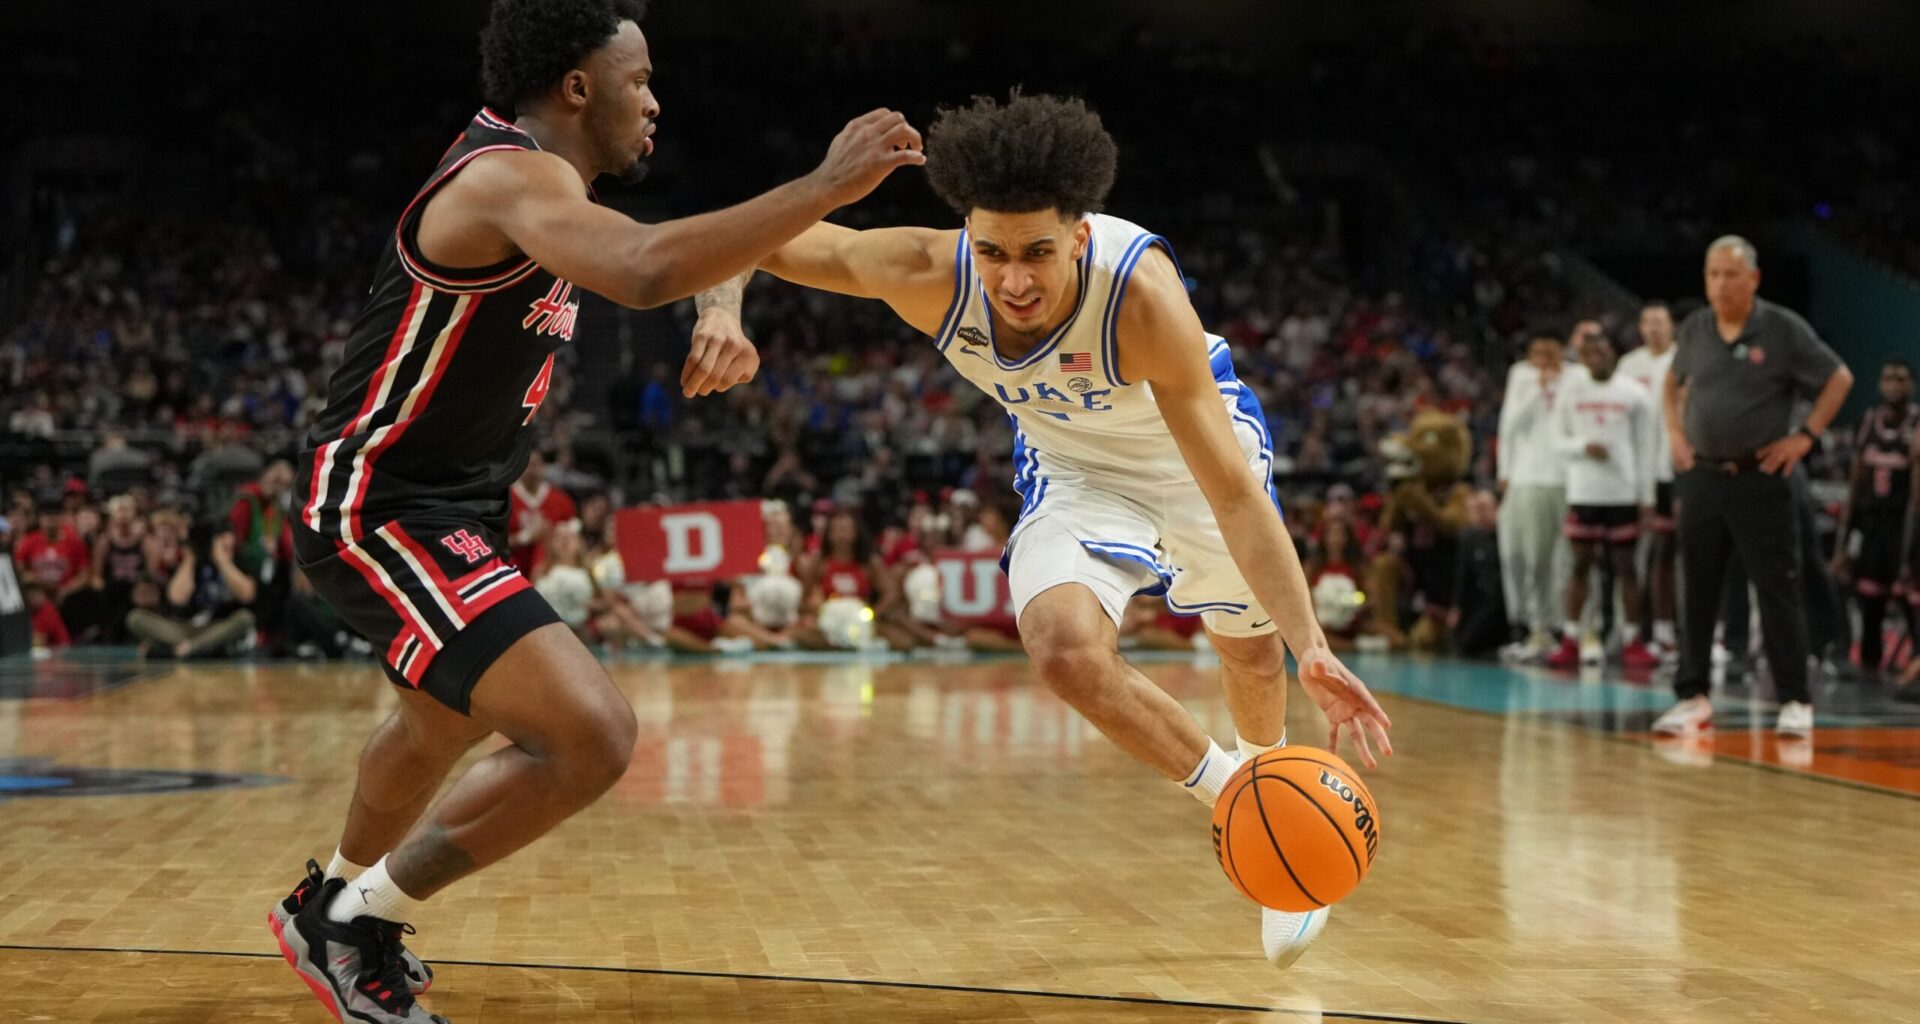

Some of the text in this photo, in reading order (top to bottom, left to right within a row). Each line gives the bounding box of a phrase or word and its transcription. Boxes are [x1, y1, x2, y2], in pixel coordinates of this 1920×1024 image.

[522, 277, 580, 341] Hou
[522, 352, 555, 426] 4
[993, 382, 1112, 411] UKE
[660, 512, 724, 574] D
[937, 558, 1015, 617] U
[1319, 769, 1378, 869] Wilson
